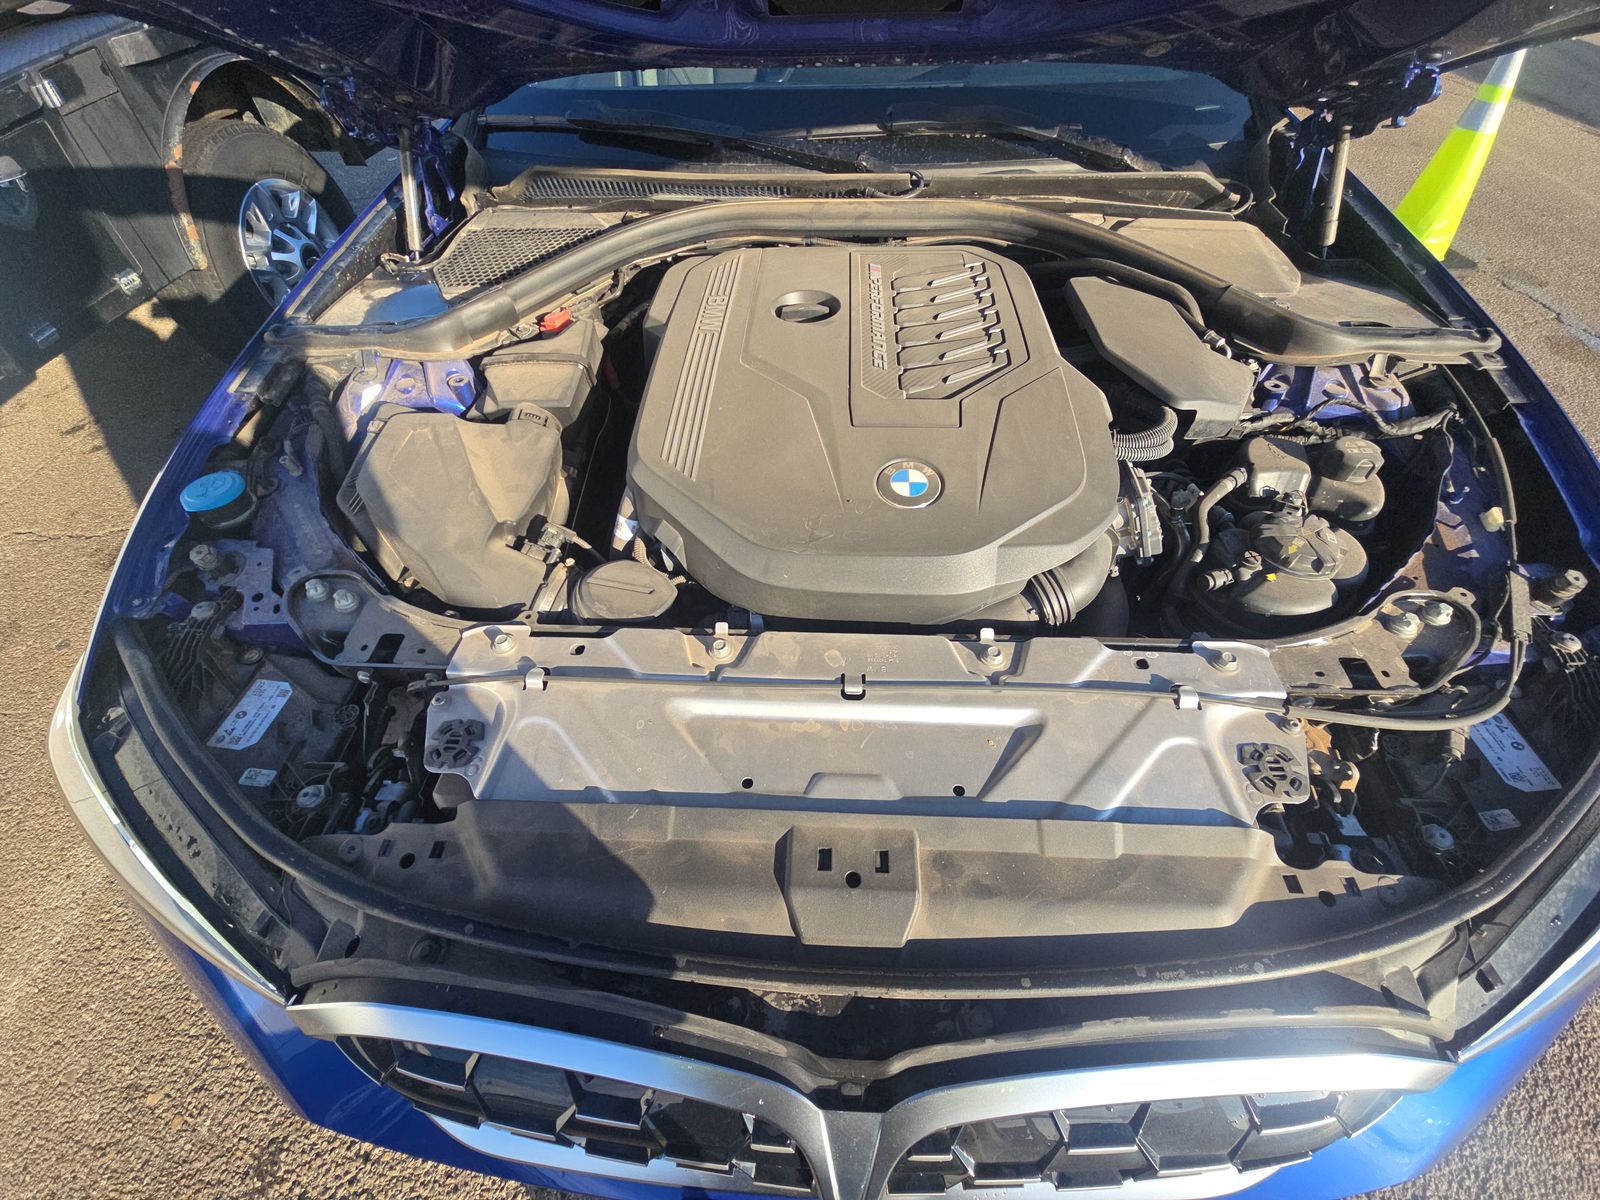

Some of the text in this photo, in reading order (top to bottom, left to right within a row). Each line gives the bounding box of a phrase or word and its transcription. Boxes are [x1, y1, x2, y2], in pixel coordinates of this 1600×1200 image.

[699, 296, 728, 332] BMW
[869, 278, 887, 370] PERFORMANCE
[885, 461, 935, 476] BMW
